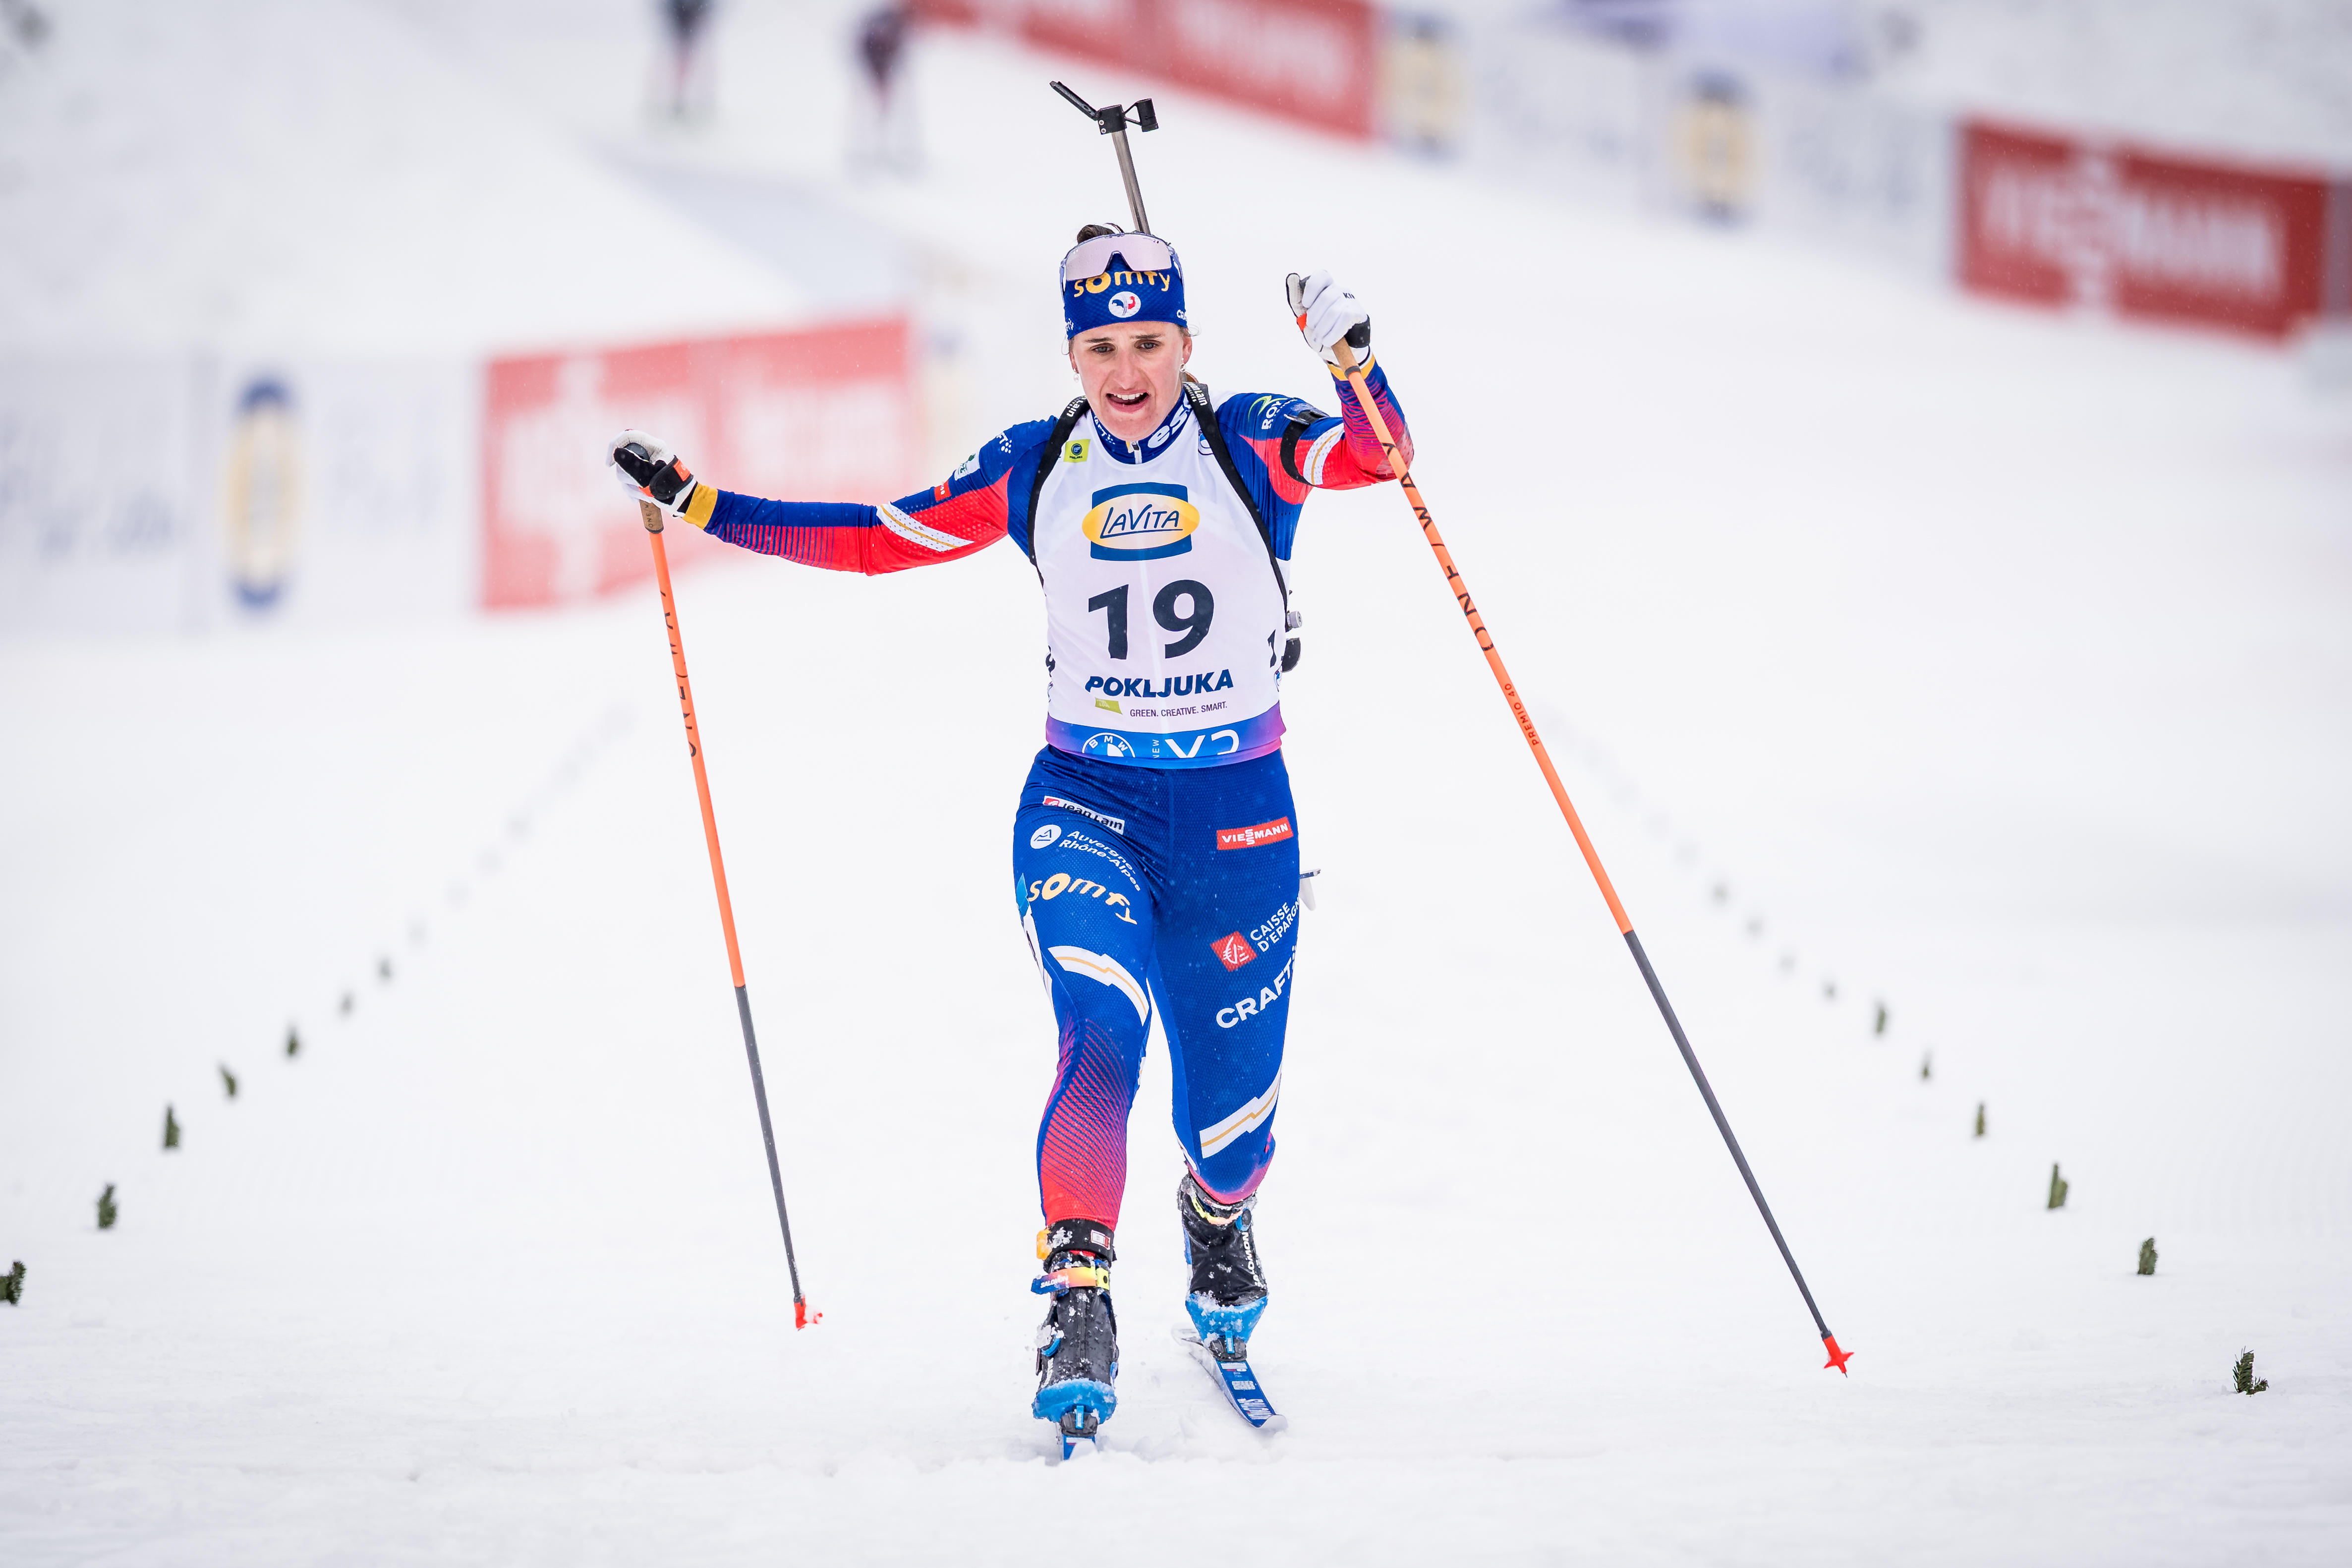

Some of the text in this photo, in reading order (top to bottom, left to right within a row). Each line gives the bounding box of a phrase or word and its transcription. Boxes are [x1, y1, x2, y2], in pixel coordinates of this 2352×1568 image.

[1088, 579, 1214, 660] 19
[1085, 668, 1234, 698] POKLJUKA
[1130, 701, 1227, 717] GREEN. CREATIVE. SMART.
[1504, 683, 1540, 746] PREMIO 40
[1089, 735, 1128, 751] BMW
[1058, 839, 1141, 891] Rhône-Alpes
[1067, 830, 1136, 874] Auvergne-
[1028, 872, 1138, 925] somfy
[1250, 902, 1290, 941] CAISSE
[1257, 895, 1299, 952] D'EPARGN
[1216, 957, 1292, 1029] CRAFT
